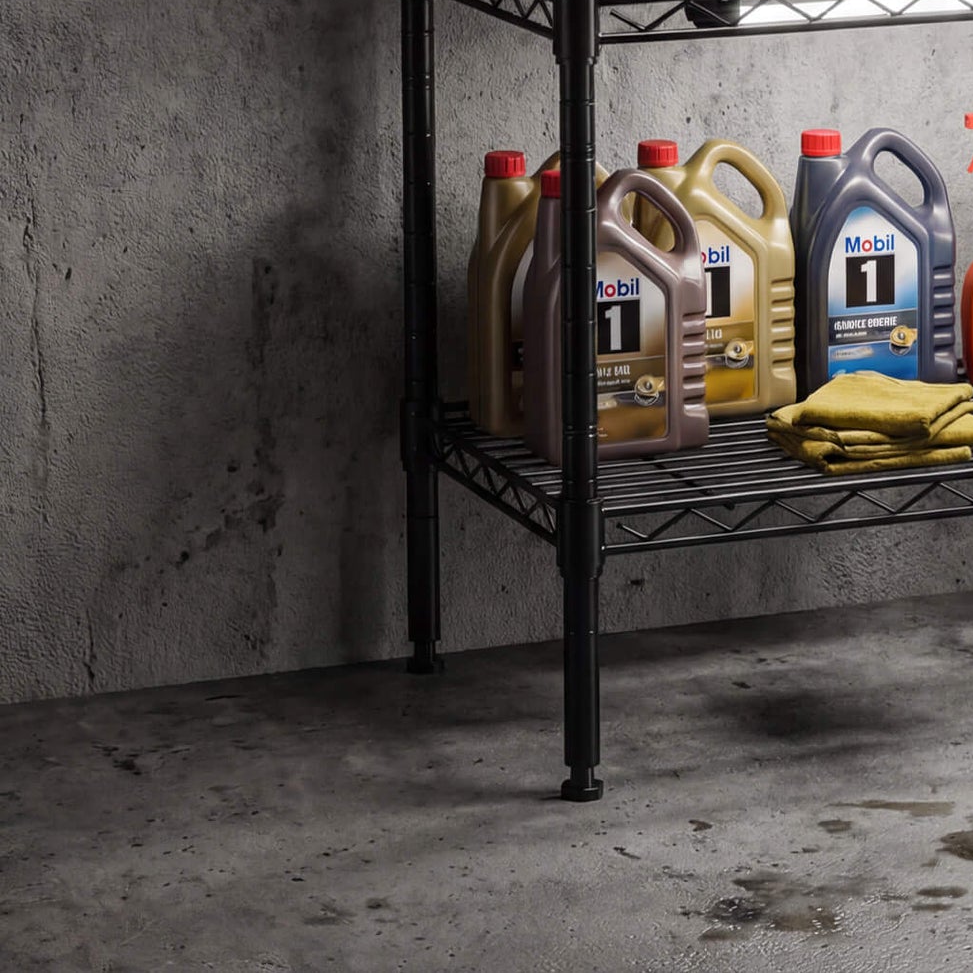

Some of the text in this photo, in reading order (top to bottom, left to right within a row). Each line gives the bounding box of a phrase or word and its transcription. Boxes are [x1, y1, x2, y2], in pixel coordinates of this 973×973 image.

[701, 245, 730, 264] bil
[845, 234, 895, 253] Mobil
[860, 260, 877, 303] 1
[605, 305, 622, 351] 1
